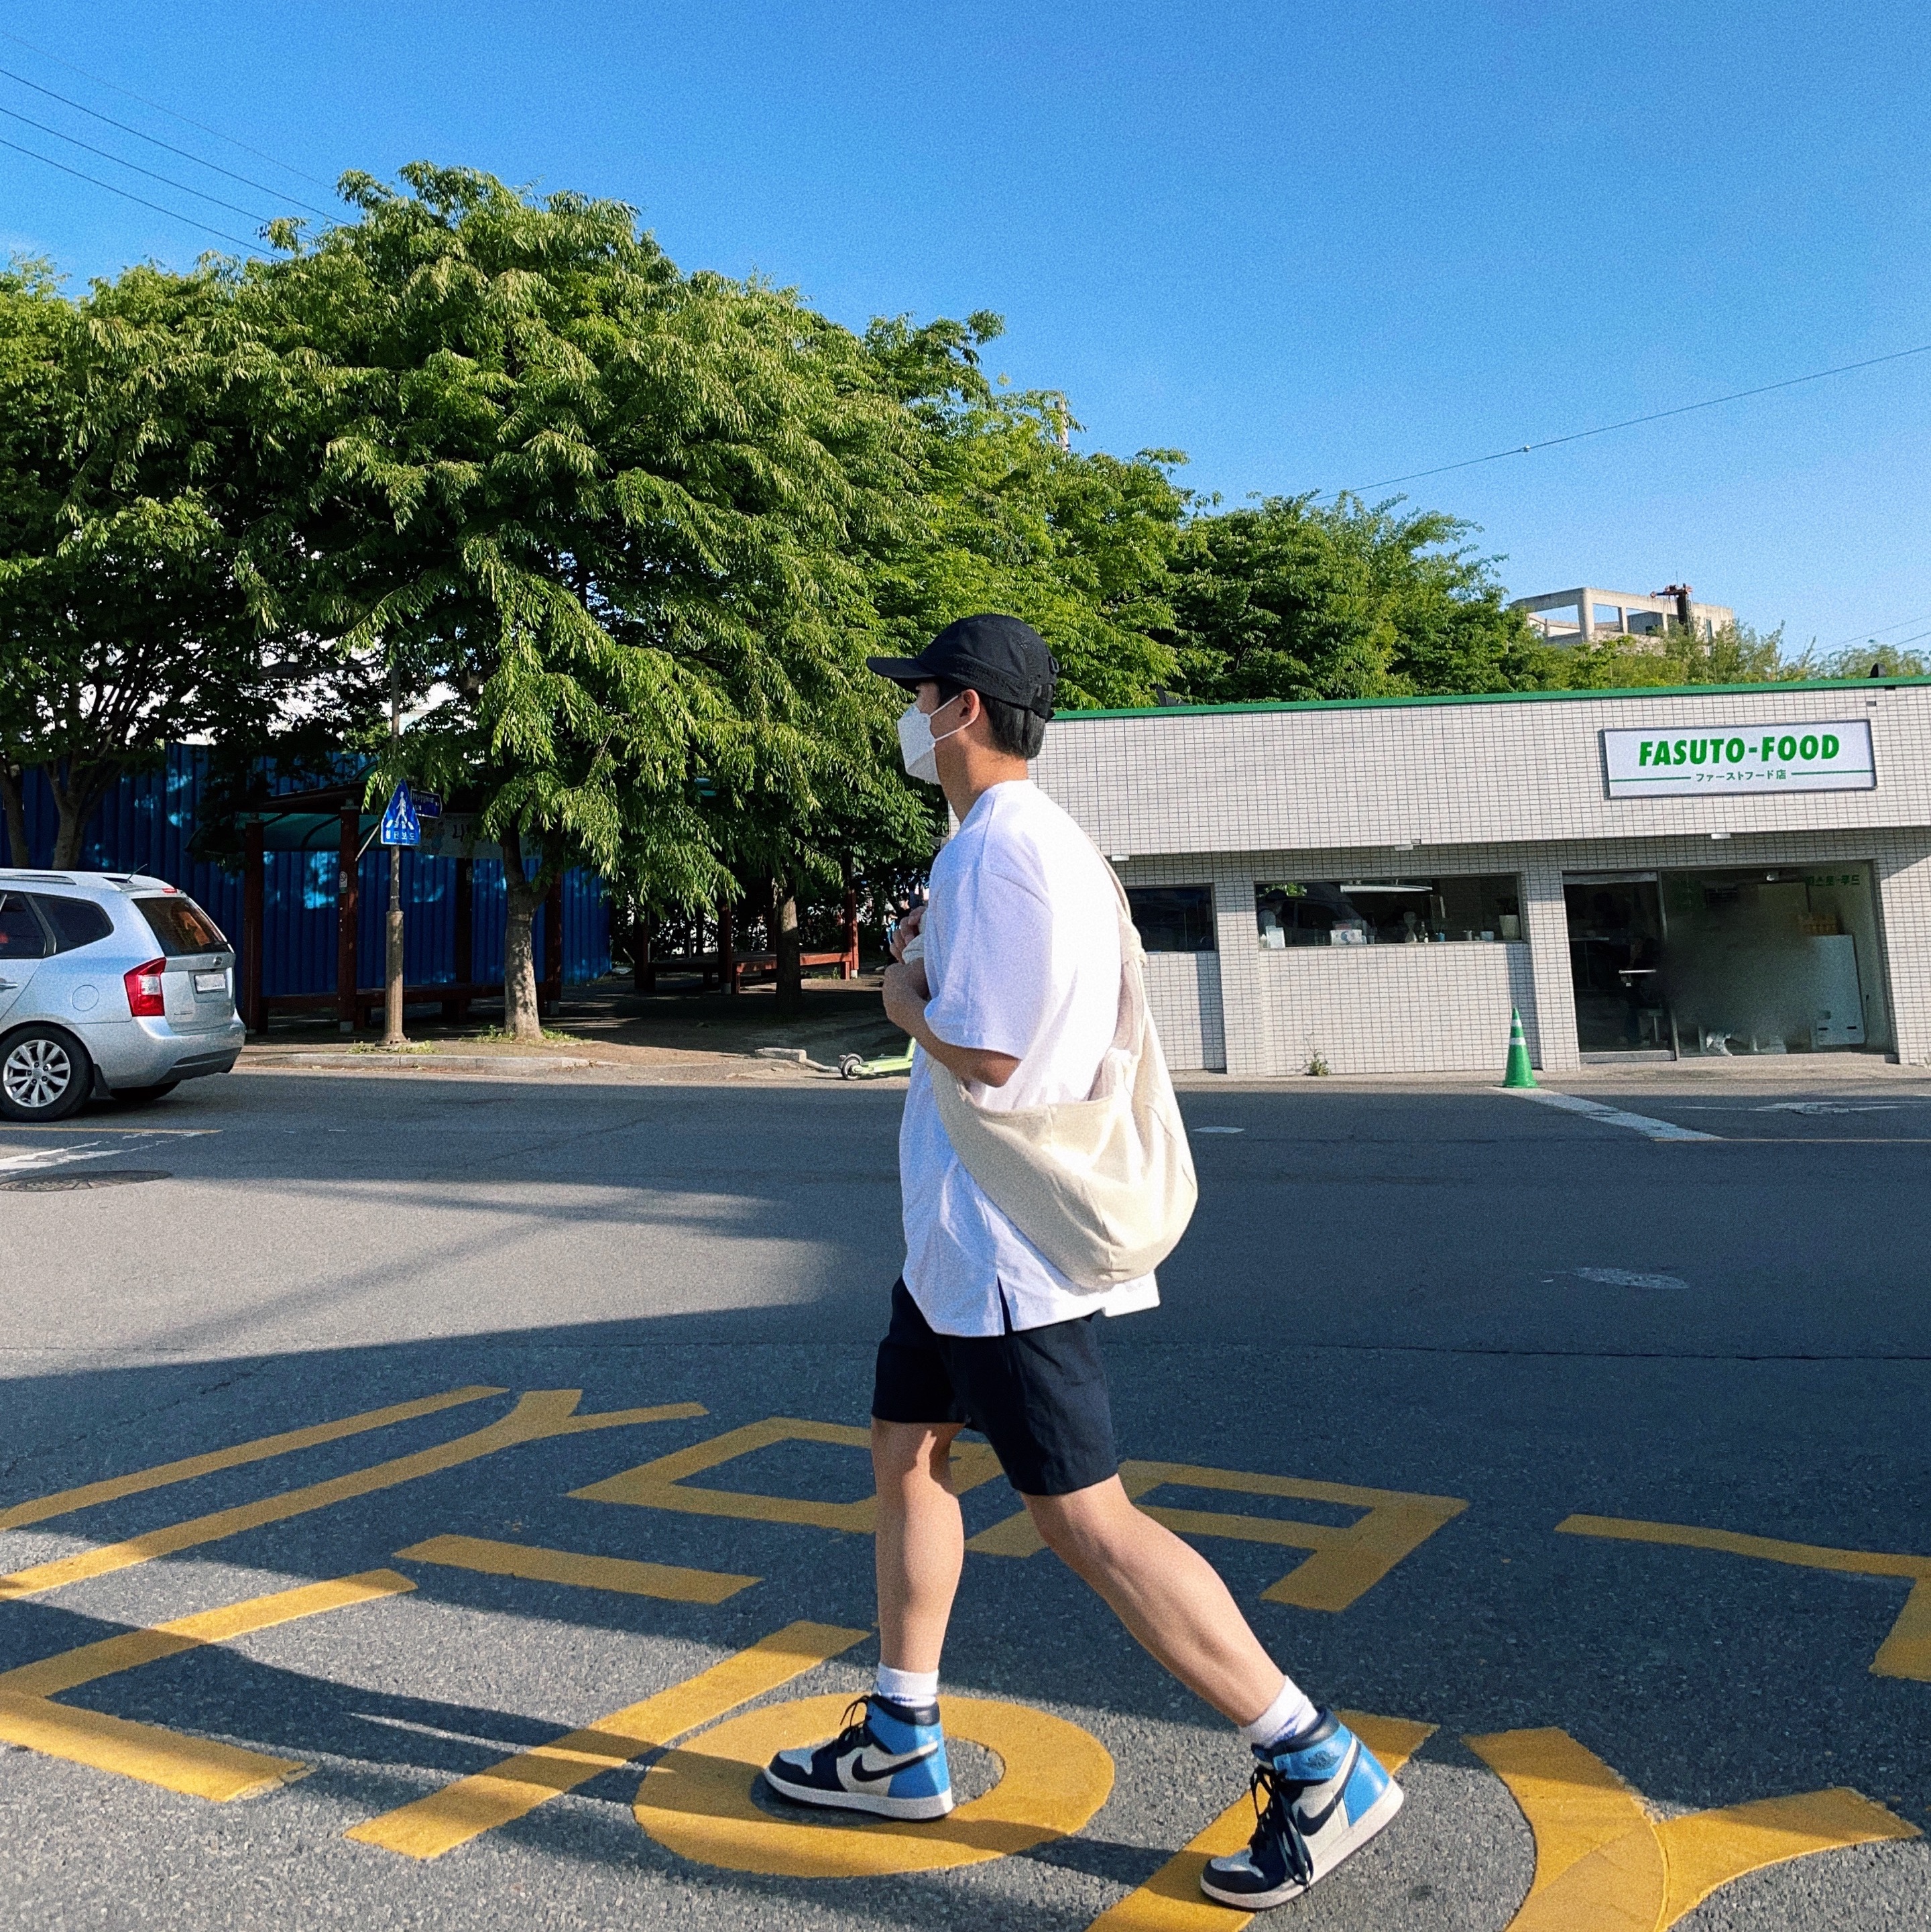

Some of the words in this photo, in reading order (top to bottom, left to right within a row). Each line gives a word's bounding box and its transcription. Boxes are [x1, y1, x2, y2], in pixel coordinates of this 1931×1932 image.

[1639, 734, 1840, 766] FASUTO-FOOD
[1696, 770, 1787, 783] ファーストフード店
[386, 830, 415, 840] 단보도
